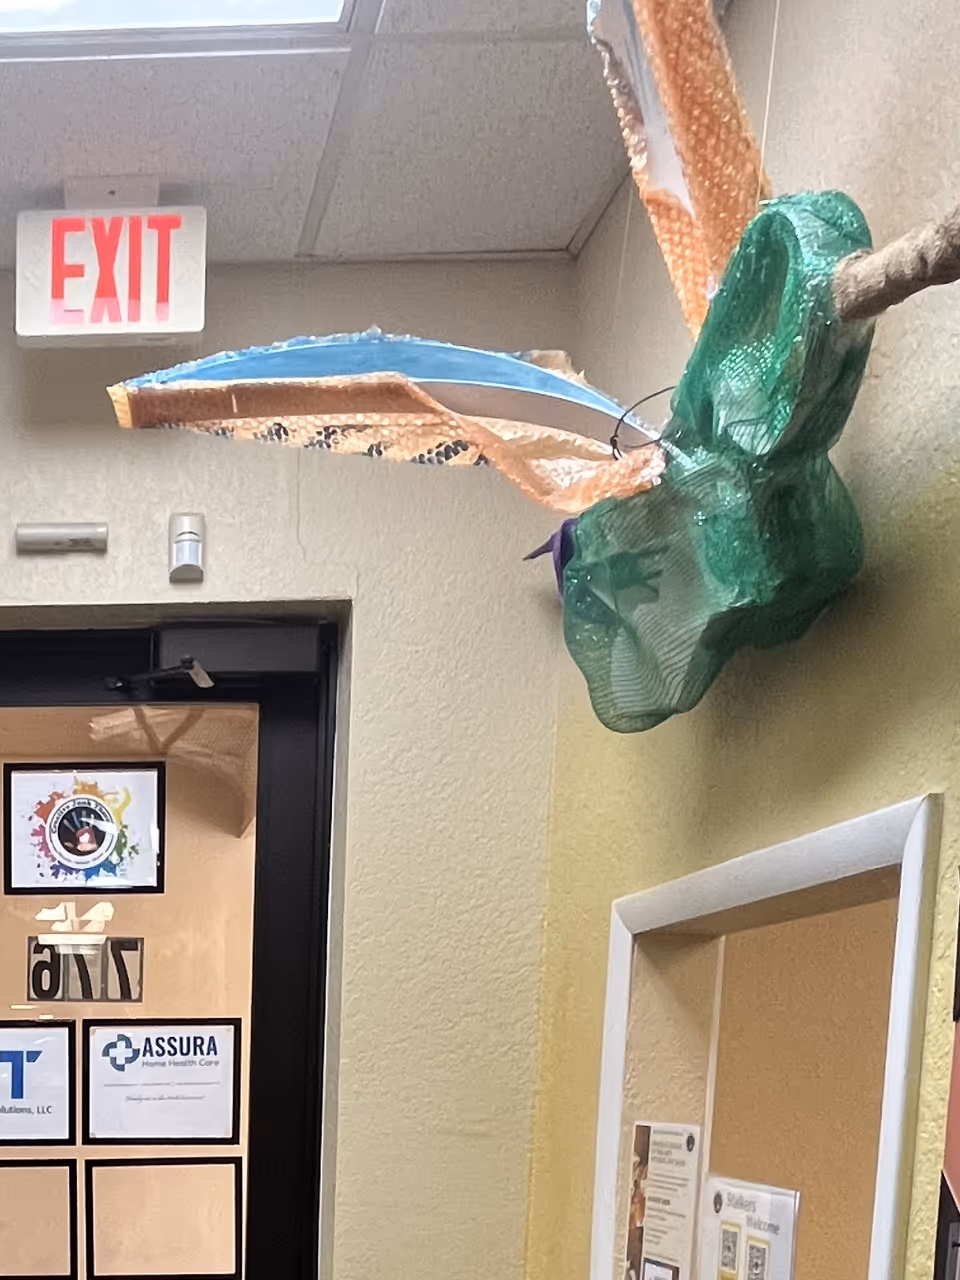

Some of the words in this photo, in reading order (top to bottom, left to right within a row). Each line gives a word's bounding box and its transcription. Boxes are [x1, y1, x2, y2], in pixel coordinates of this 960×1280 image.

[50, 215, 182, 324] EXIT
[142, 1035, 218, 1058] ASSURA
[141, 1060, 167, 1068] Home
[168, 1059, 197, 1067] Health
[198, 1058, 220, 1067] Care
[36, 1105, 53, 1114] LLC
[746, 1214, 780, 1236] Welcome
